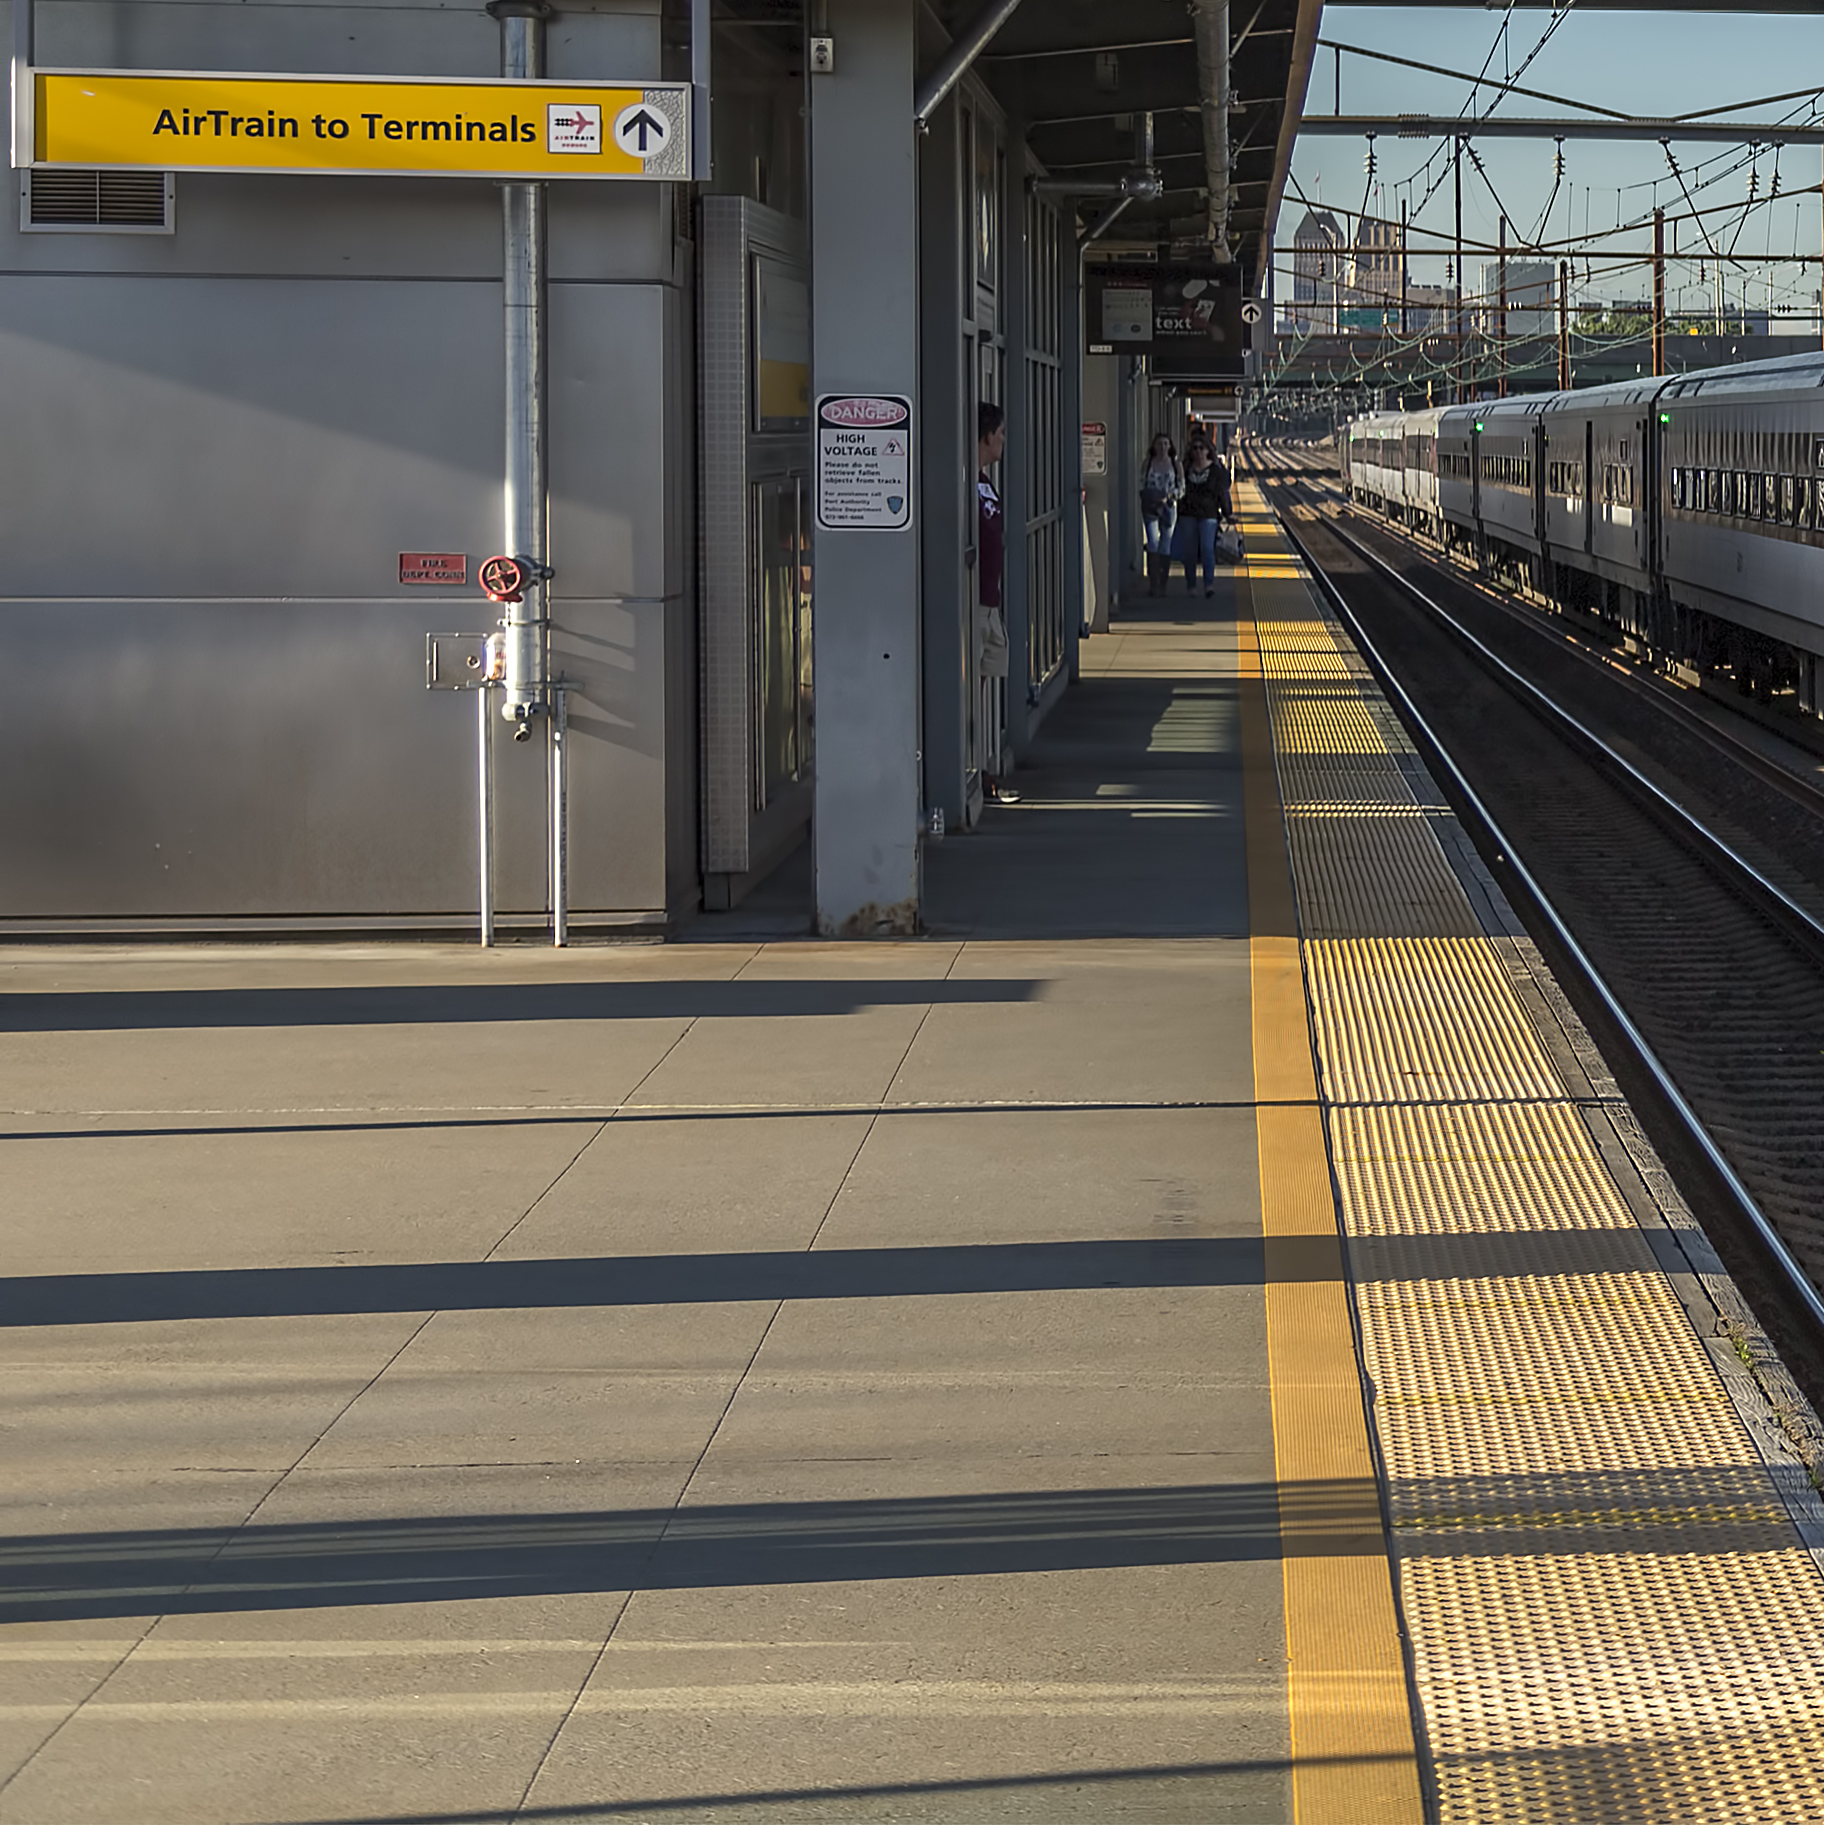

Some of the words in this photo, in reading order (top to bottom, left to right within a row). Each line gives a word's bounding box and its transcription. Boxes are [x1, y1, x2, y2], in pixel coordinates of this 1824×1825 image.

[152, 108, 299, 138] AirTrain
[311, 114, 349, 139] to
[361, 113, 537, 142] Terminals
[1155, 316, 1192, 329] text
[831, 406, 897, 419] DANGER
[836, 434, 865, 443] HIGH
[824, 447, 877, 456] VOLTAGE
